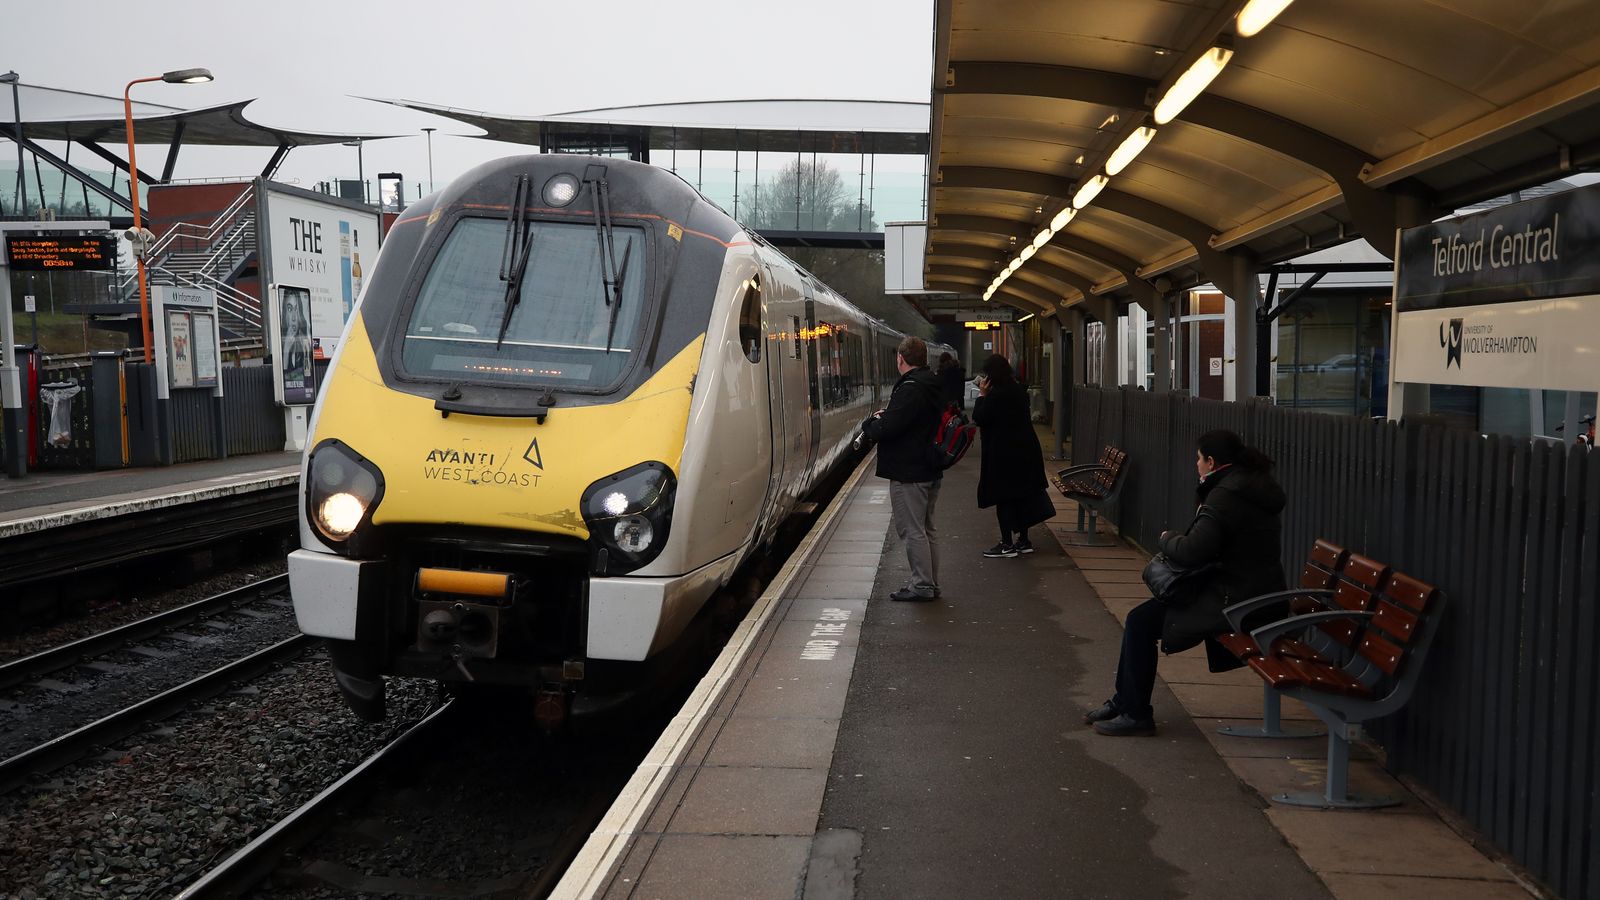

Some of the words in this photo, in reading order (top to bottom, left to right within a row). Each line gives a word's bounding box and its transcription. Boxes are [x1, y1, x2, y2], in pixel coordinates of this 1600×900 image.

[289, 217, 323, 254] THE
[1432, 228, 1486, 277] Telford
[1489, 213, 1559, 269] Central
[289, 256, 327, 274] WHISKY
[1464, 325, 1487, 335] UNIVERSITY
[1487, 324, 1494, 333] OF
[1463, 336, 1538, 354] WOLVERHAMPTON
[426, 450, 495, 466] AVANTI
[424, 466, 474, 482] WEST
[481, 470, 542, 487] COAST
[810, 623, 848, 637] THE
[799, 640, 840, 660] MIND
